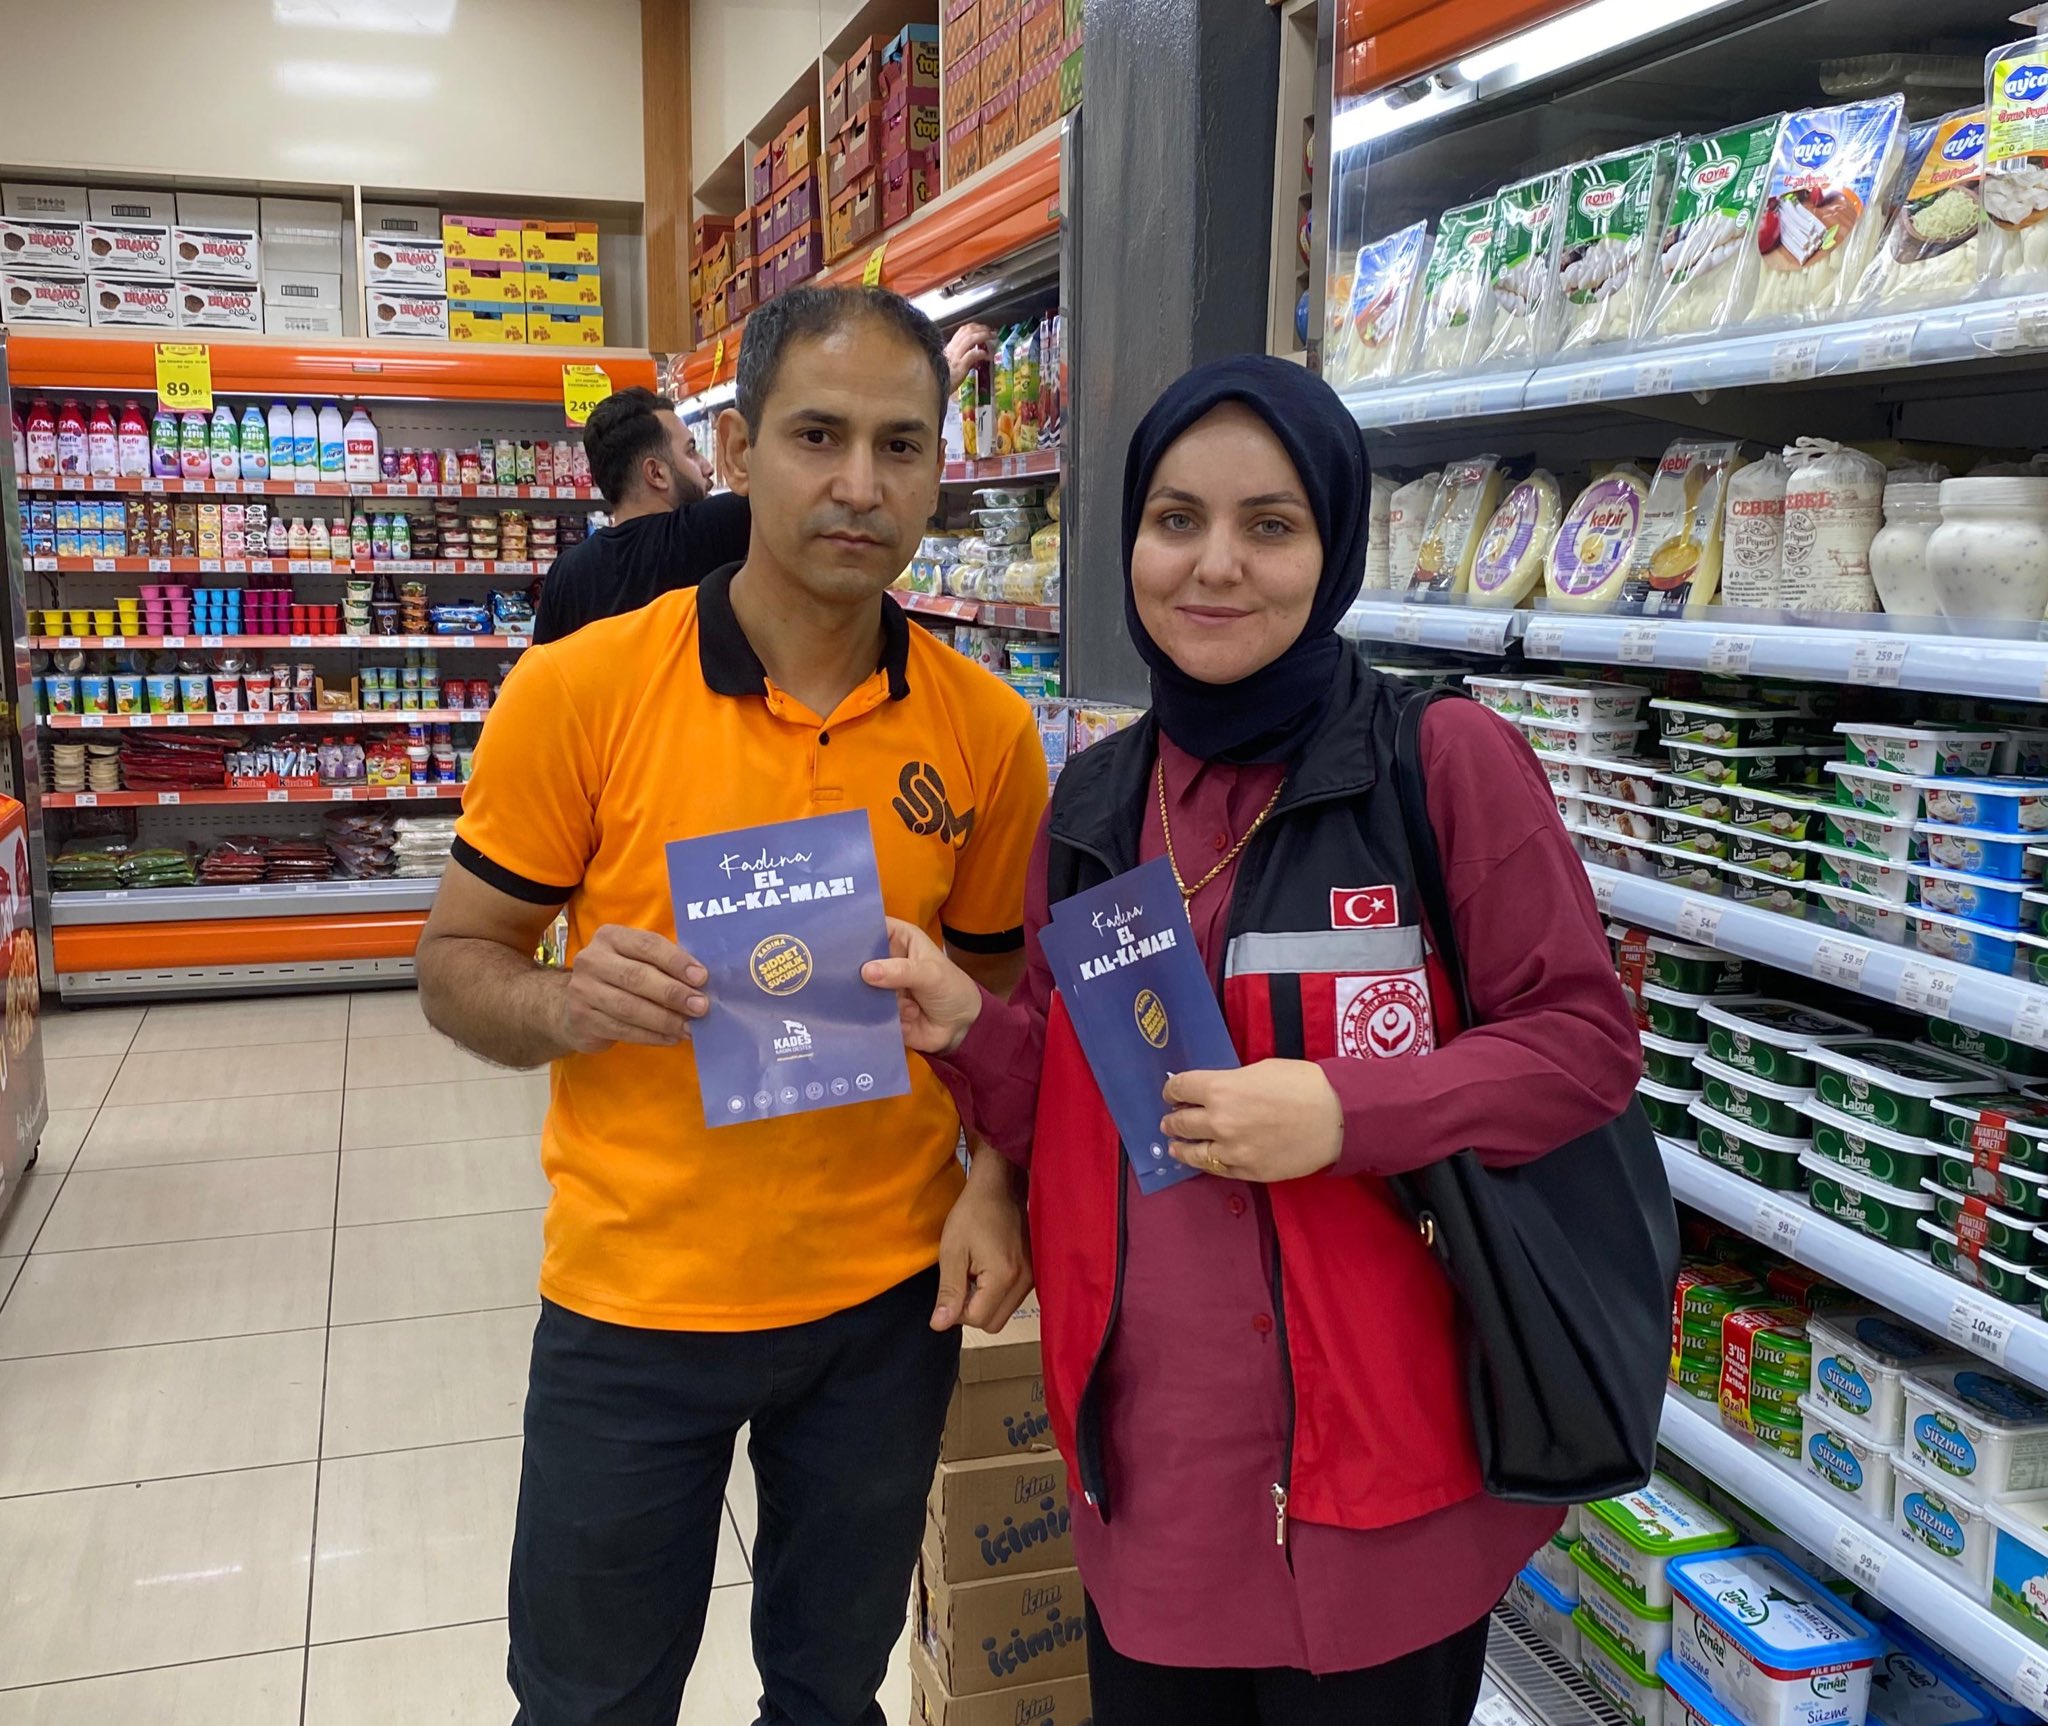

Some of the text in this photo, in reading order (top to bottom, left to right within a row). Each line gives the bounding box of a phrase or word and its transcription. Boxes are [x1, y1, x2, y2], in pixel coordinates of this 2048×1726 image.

[1697, 167, 1730, 184] ROYAL
[1589, 508, 1628, 528] kebir
[1666, 722, 1689, 735] Labne
[1884, 748, 1906, 763] Labne
[1674, 760, 1693, 772] Labne
[1668, 795, 1689, 807] Labne
[1870, 789, 1890, 805] Labne
[1735, 809, 1758, 823] Labne
[1661, 830, 1683, 843] Labne
[1733, 847, 1757, 861] Labne
[753, 870, 784, 890] EL
[686, 876, 855, 921] KAL-KA-MAZ!
[1115, 925, 1136, 947] EL
[1079, 928, 1178, 981] KAL-KA-MAZ!
[1930, 978, 1954, 994] 59.95
[773, 1034, 812, 1051] KADES
[1728, 1047, 1756, 1065] Labne
[1725, 1096, 1752, 1115] Labne
[1842, 1092, 1875, 1113] Labne
[1718, 1145, 1745, 1164] Labne
[1838, 1147, 1871, 1168] Labne
[1834, 1198, 1866, 1220] Labne
[1971, 1318, 2003, 1339] 104.95
[1825, 1366, 1863, 1399] Süzme
[1922, 1423, 1966, 1459] Süzme
[1817, 1443, 1854, 1476] Süzme
[1912, 1504, 1955, 1541] Süzme
[2029, 1582, 2048, 1606] Bey
[982, 1607, 1086, 1677] içimin
[1830, 1663, 1854, 1673] BOYU
[1817, 1676, 1847, 1692] PINAR
[1807, 1706, 1849, 1725] Süzme
